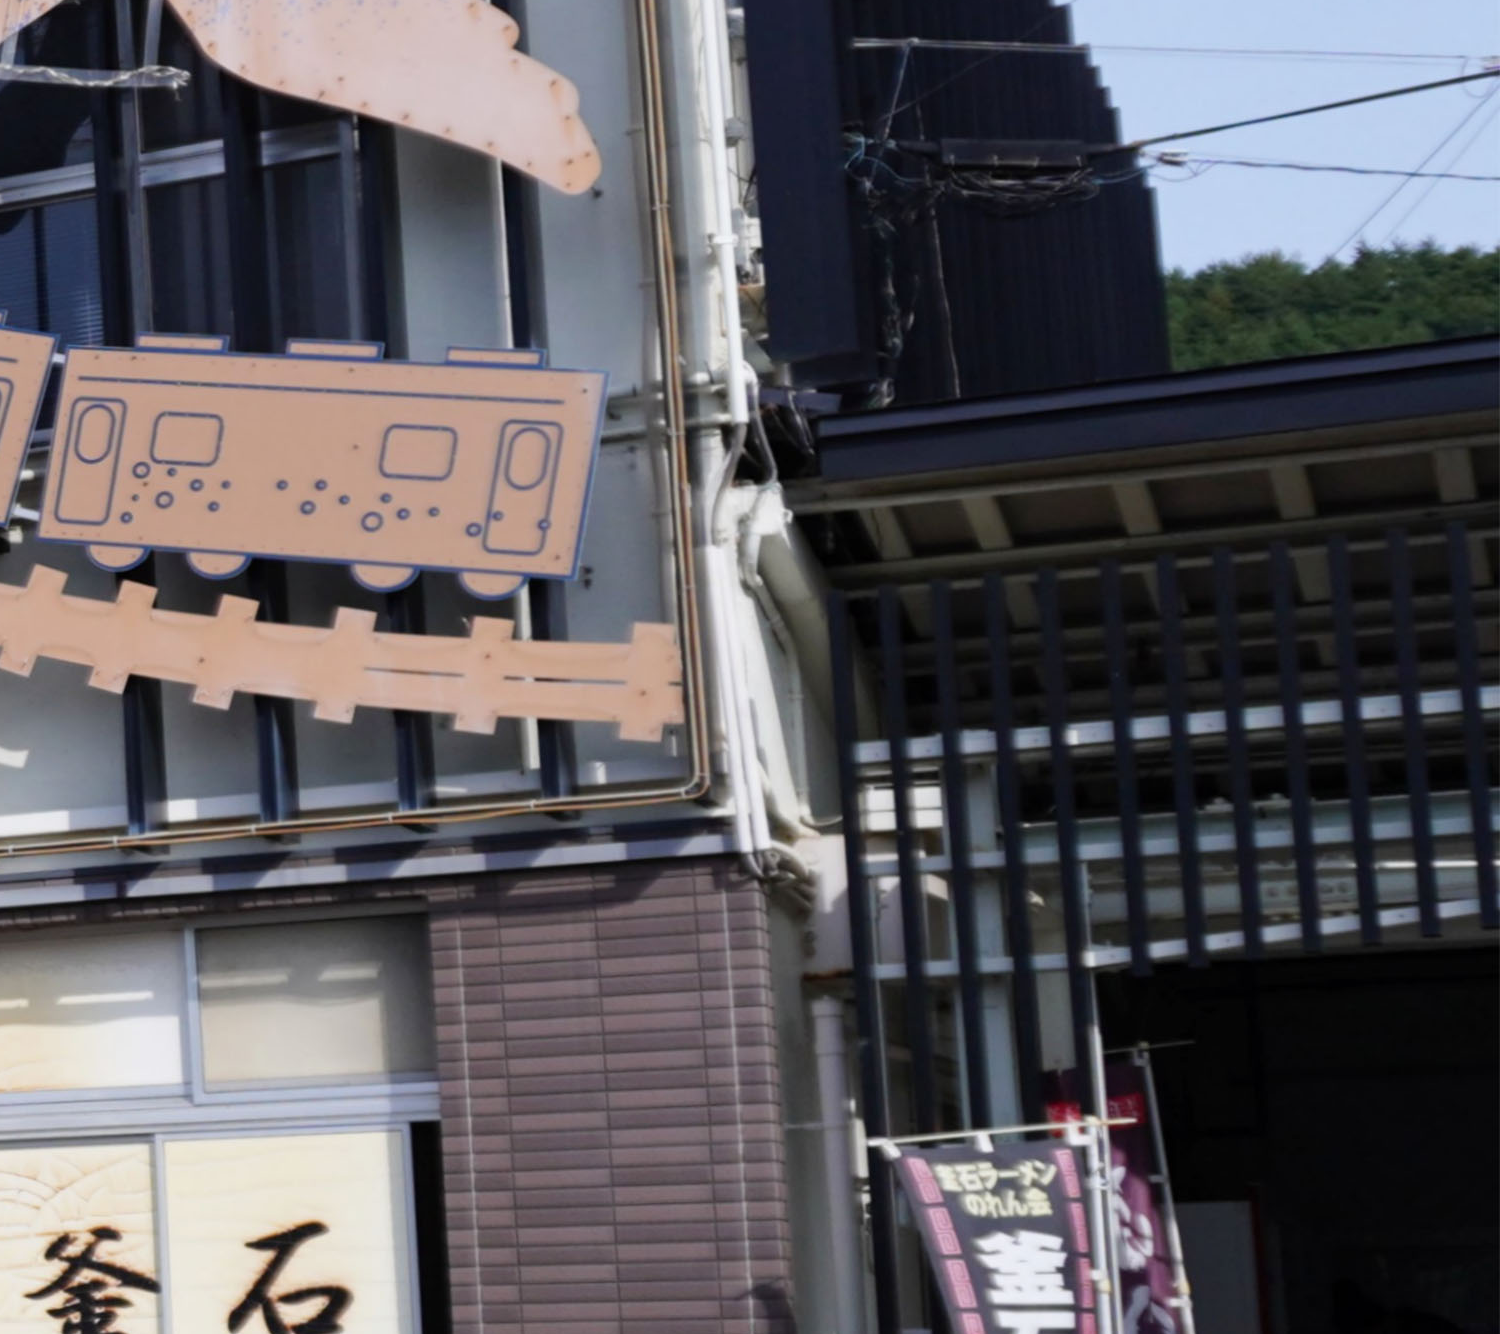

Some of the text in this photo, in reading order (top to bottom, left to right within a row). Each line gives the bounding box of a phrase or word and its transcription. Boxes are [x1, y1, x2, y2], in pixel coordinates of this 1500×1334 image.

[934, 1159, 1057, 1192] 釜石ラーメン
[964, 1187, 1053, 1218] のれん会
